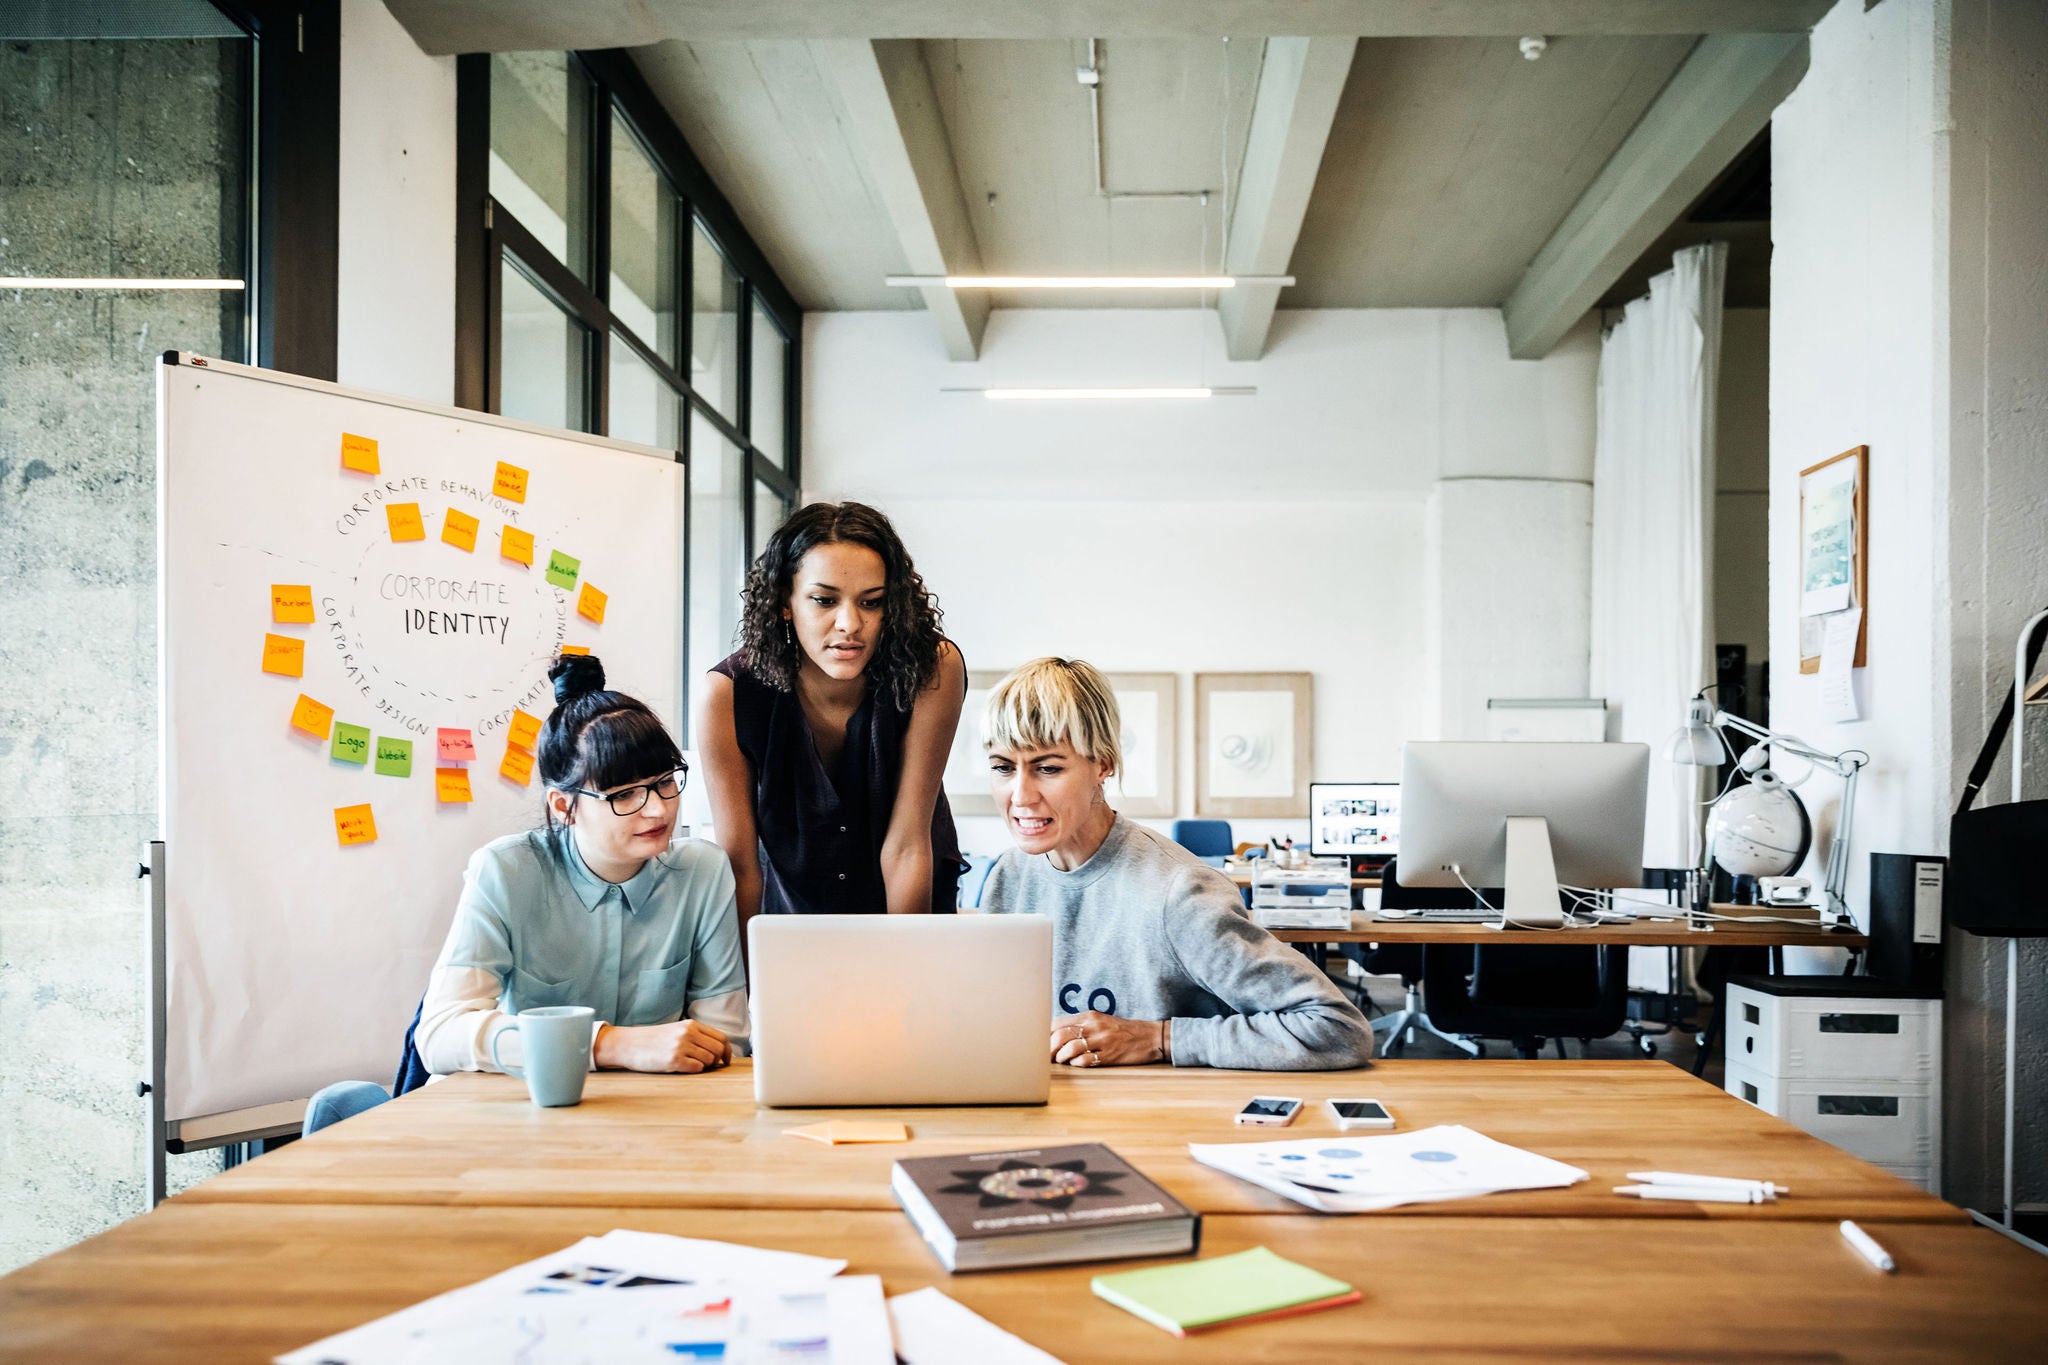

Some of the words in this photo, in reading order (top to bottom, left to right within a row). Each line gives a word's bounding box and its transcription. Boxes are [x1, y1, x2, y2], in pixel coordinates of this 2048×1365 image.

[336, 477, 429, 535] CORPORATE
[440, 480, 520, 523] BEHAVIOUR
[380, 573, 510, 604] CORPORATE
[405, 608, 509, 645] IDENTITY
[322, 597, 371, 698] CORPORATE
[375, 698, 430, 735] DESIGN
[338, 731, 365, 753] Logo
